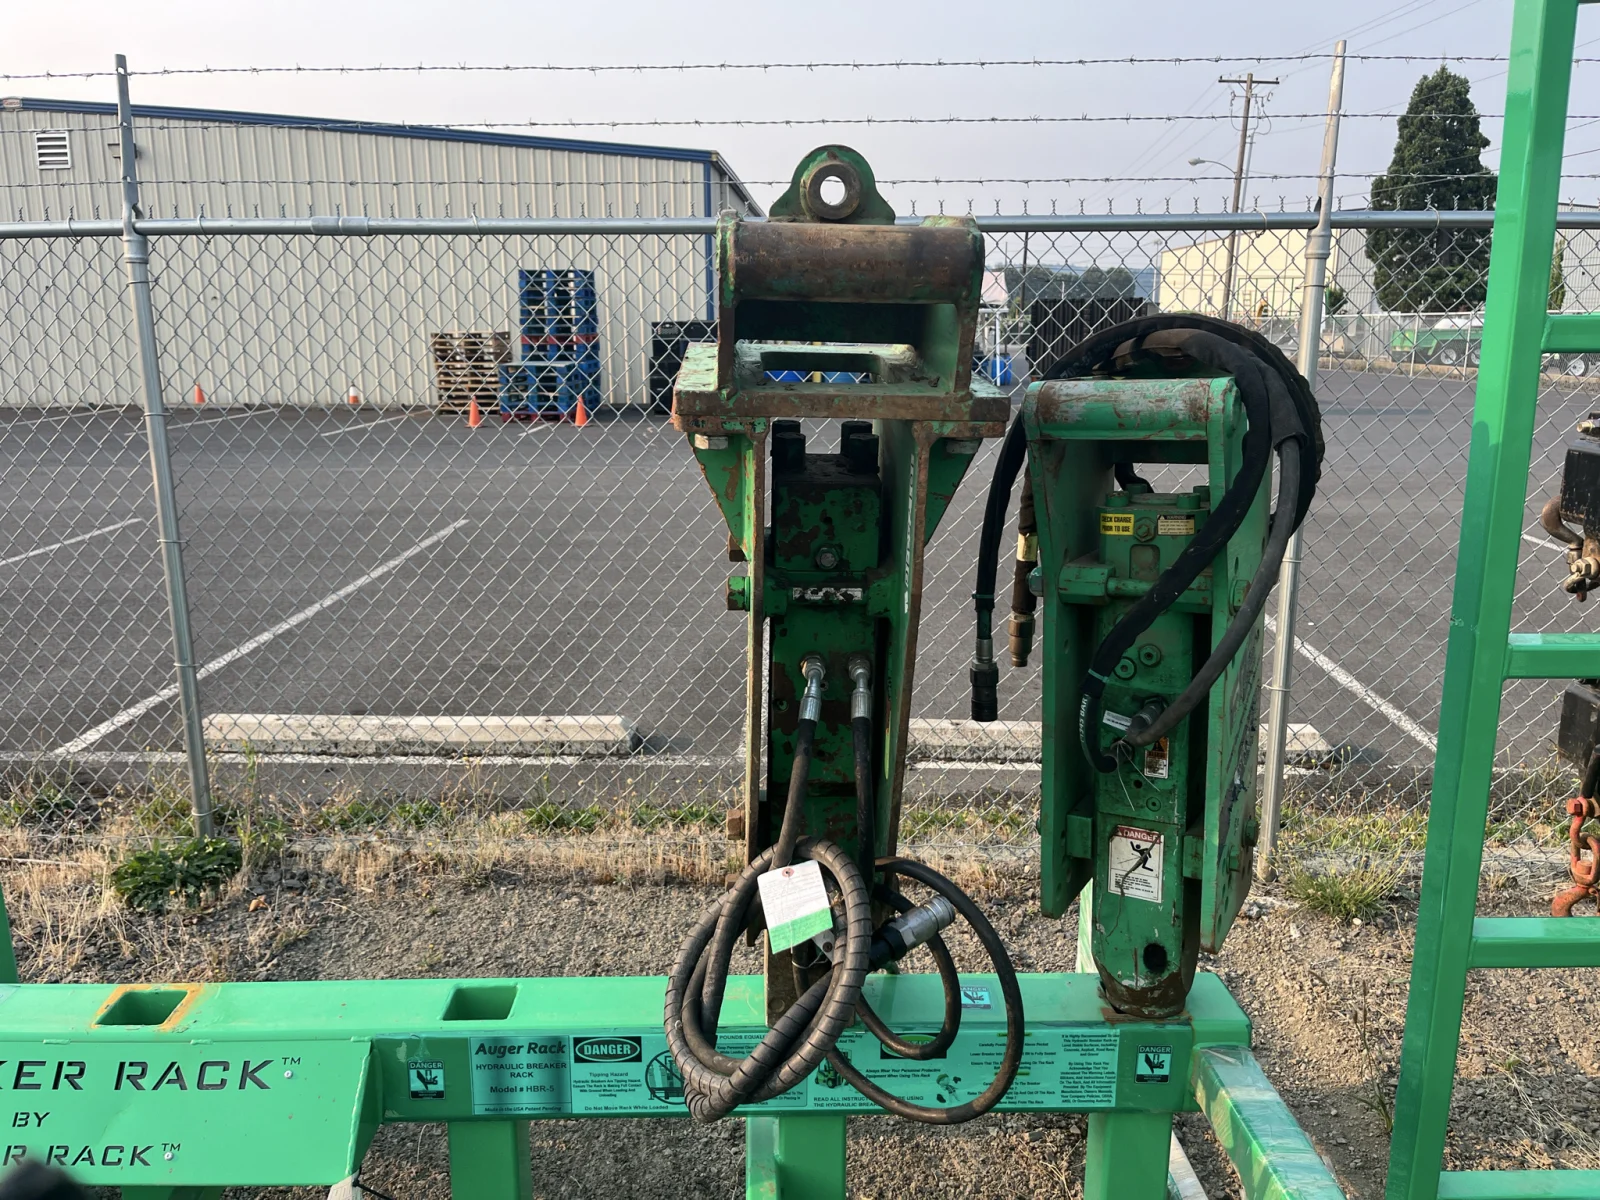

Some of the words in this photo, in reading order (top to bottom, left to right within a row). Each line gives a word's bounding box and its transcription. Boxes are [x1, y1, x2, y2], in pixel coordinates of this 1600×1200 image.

[1080, 697, 1088, 717] BAR
[475, 1042, 524, 1058] Auger
[527, 1041, 566, 1054] Rack
[584, 1044, 631, 1055] DANGER
[0, 1060, 86, 1091] ER
[114, 1060, 274, 1091] RACK
[12, 1112, 50, 1127] BY
[46, 1145, 154, 1166] RACK
